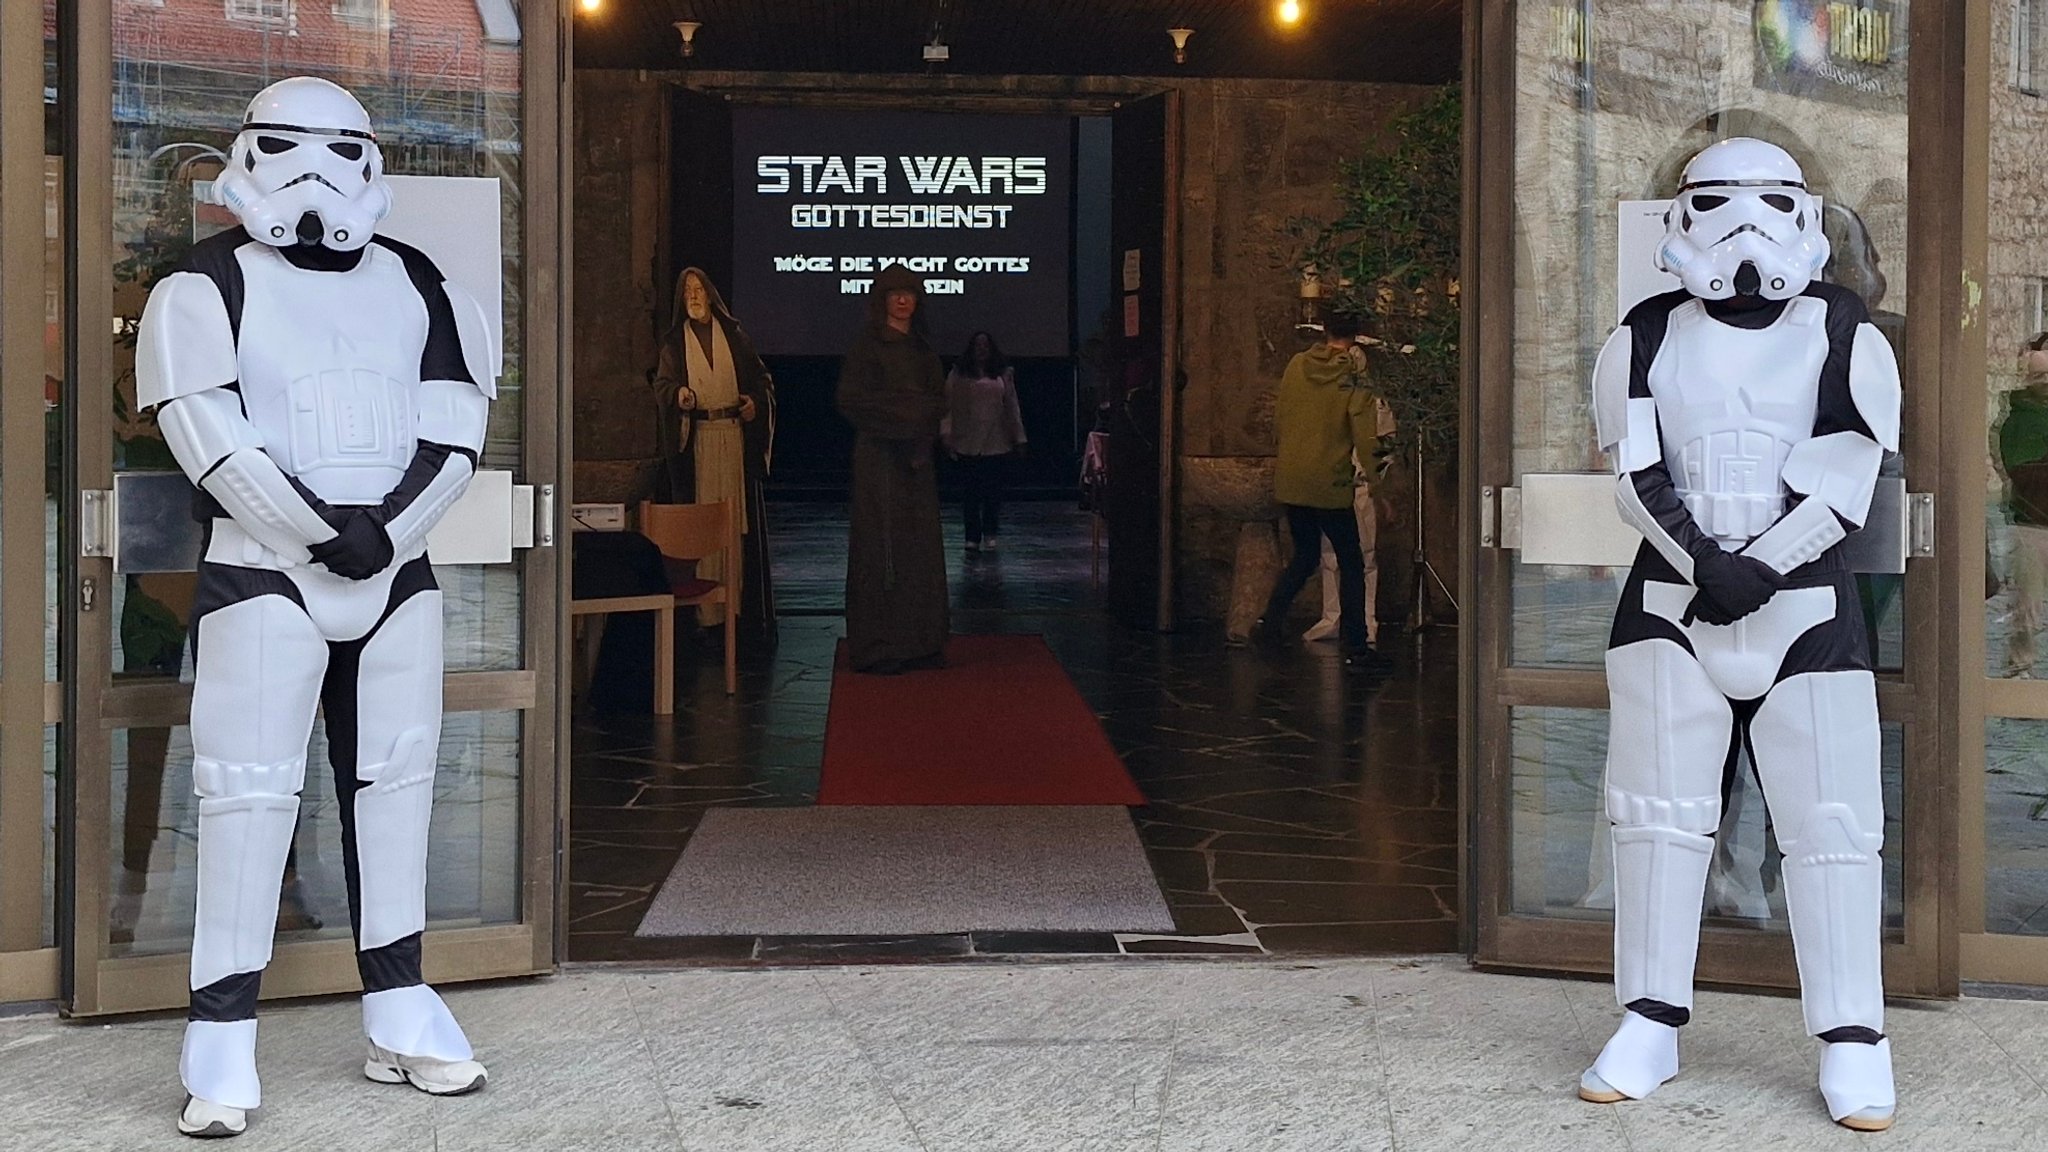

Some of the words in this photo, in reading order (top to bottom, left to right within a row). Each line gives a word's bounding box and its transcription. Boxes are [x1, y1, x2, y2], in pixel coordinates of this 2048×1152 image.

[758, 156, 886, 193] STAR
[899, 157, 1046, 193] WARS
[792, 205, 1012, 228] GOTTESDIENST
[774, 254, 833, 271] MÖGE
[840, 257, 873, 271] DIE
[955, 257, 1029, 272] GOTTES
[841, 279, 874, 293] MIT
[924, 280, 963, 293] SEIN
